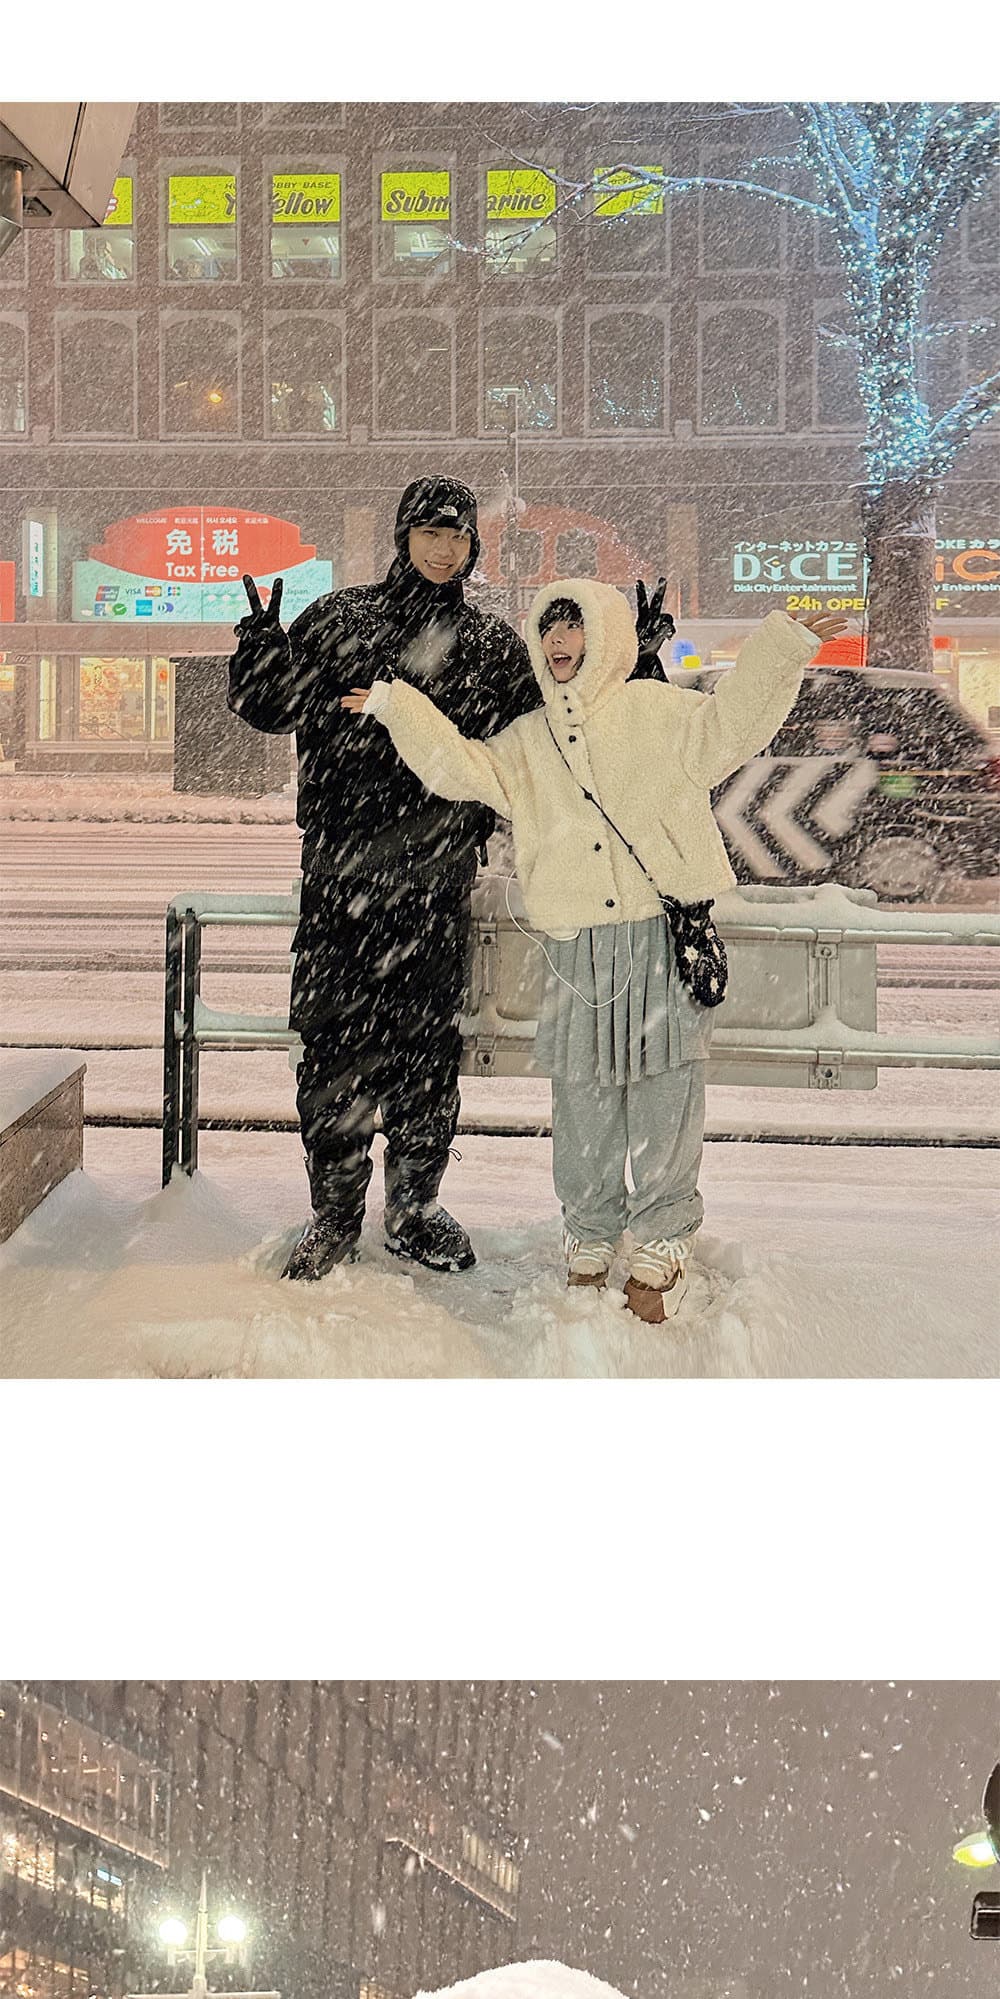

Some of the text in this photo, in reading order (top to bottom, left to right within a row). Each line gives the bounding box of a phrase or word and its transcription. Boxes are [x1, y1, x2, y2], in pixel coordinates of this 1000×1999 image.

[734, 541, 858, 552] インターネットカフェ
[165, 562, 239, 577] Tax Free
[733, 584, 857, 593] Disk City Entertainment
[786, 595, 822, 611] 24h
